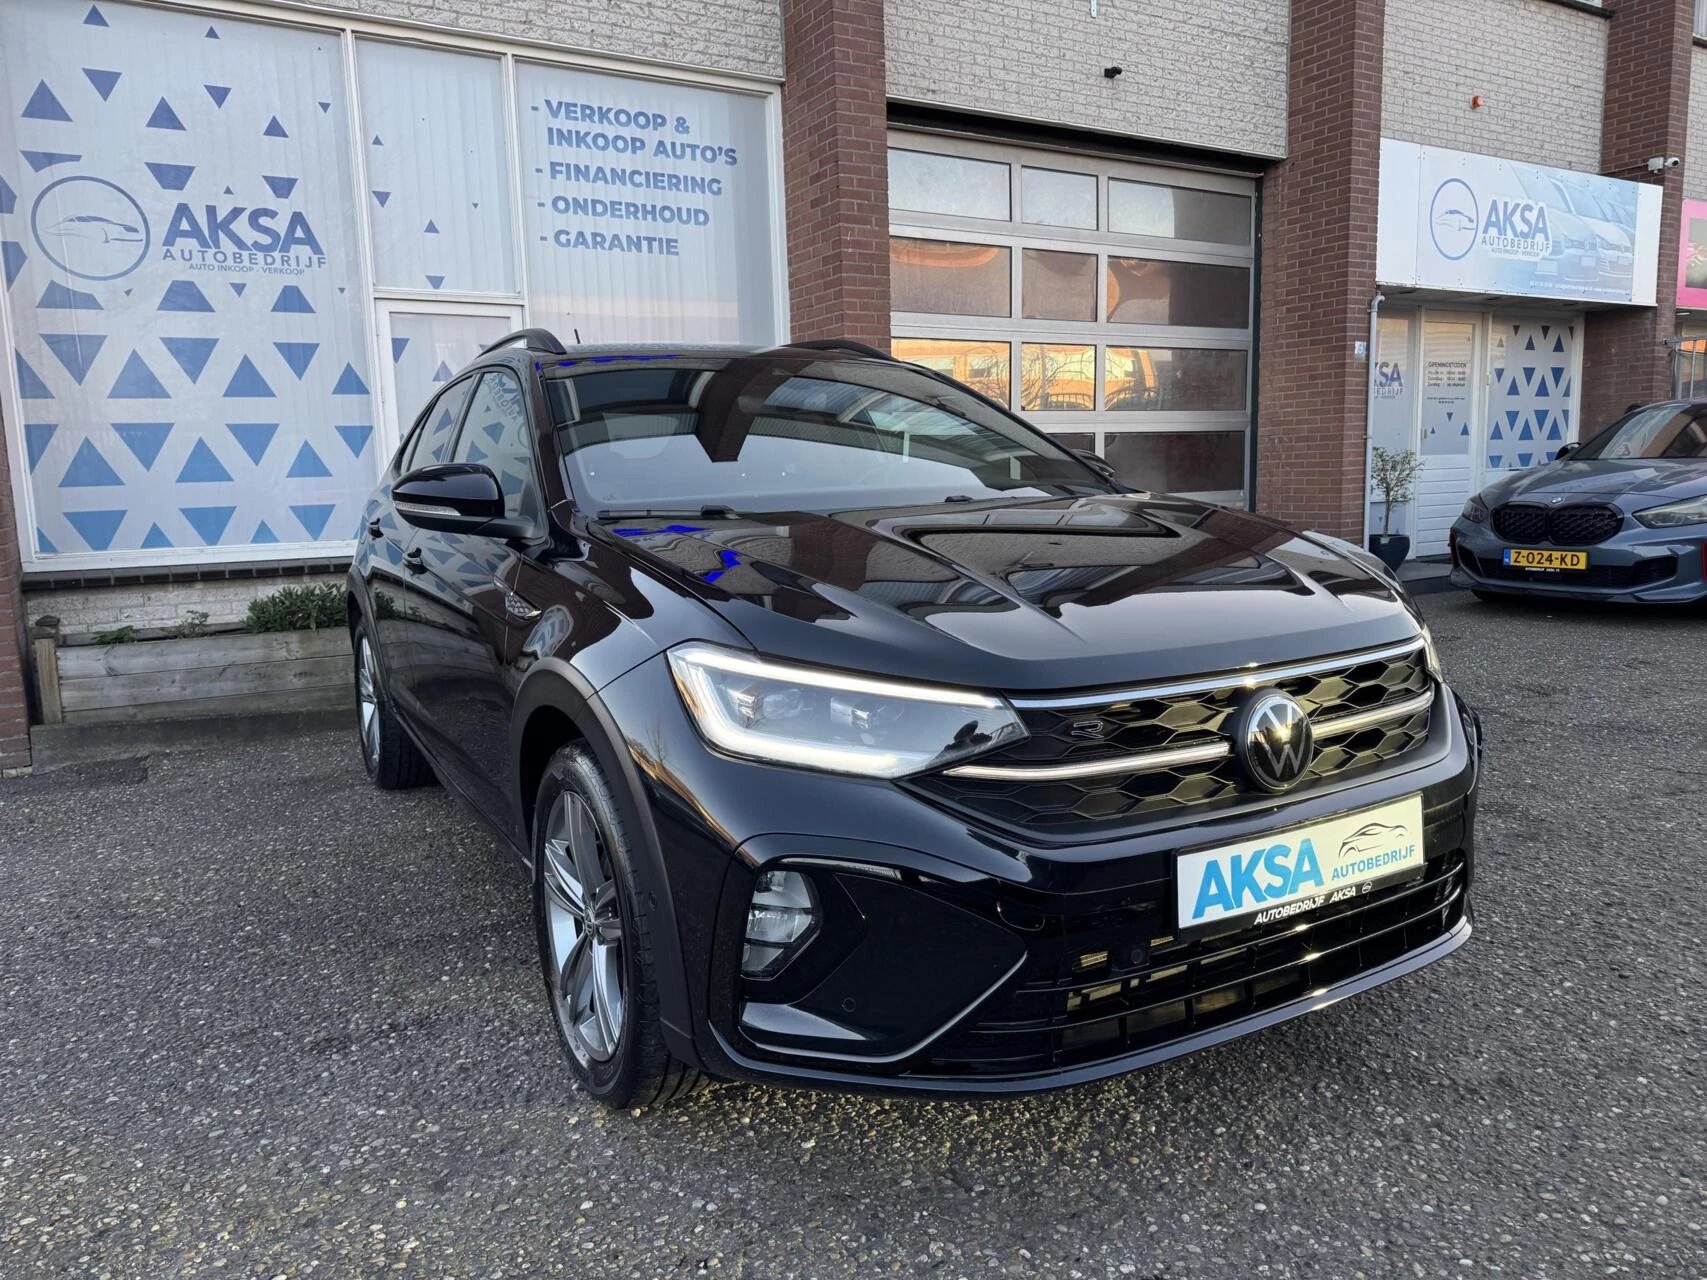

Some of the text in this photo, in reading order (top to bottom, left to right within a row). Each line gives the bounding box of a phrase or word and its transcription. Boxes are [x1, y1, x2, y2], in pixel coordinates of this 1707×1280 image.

[544, 99, 667, 131] VERKOOP
[674, 116, 690, 134] &
[547, 127, 738, 166] INKOOP AUTO'S
[549, 161, 723, 196] FINANCIERING
[551, 195, 710, 226] ONDERHOUD
[1482, 199, 1550, 242] AKSA
[162, 203, 325, 256] AKSA
[554, 229, 680, 256] GARANTIE
[1481, 235, 1551, 253] AUTOBEDRIJF
[162, 248, 327, 269] AUTOBEDRIJF
[189, 263, 215, 272] AUTO
[217, 265, 254, 273] INKOOP
[263, 267, 305, 276] VERKOOP
[1513, 551, 1580, 567] Z-024-KD
[1192, 838, 1325, 920] AKSA
[1331, 844, 1416, 881] AUTOBEDRIJF
[1253, 886, 1356, 925] AUTOBEDRIJF AKSA
